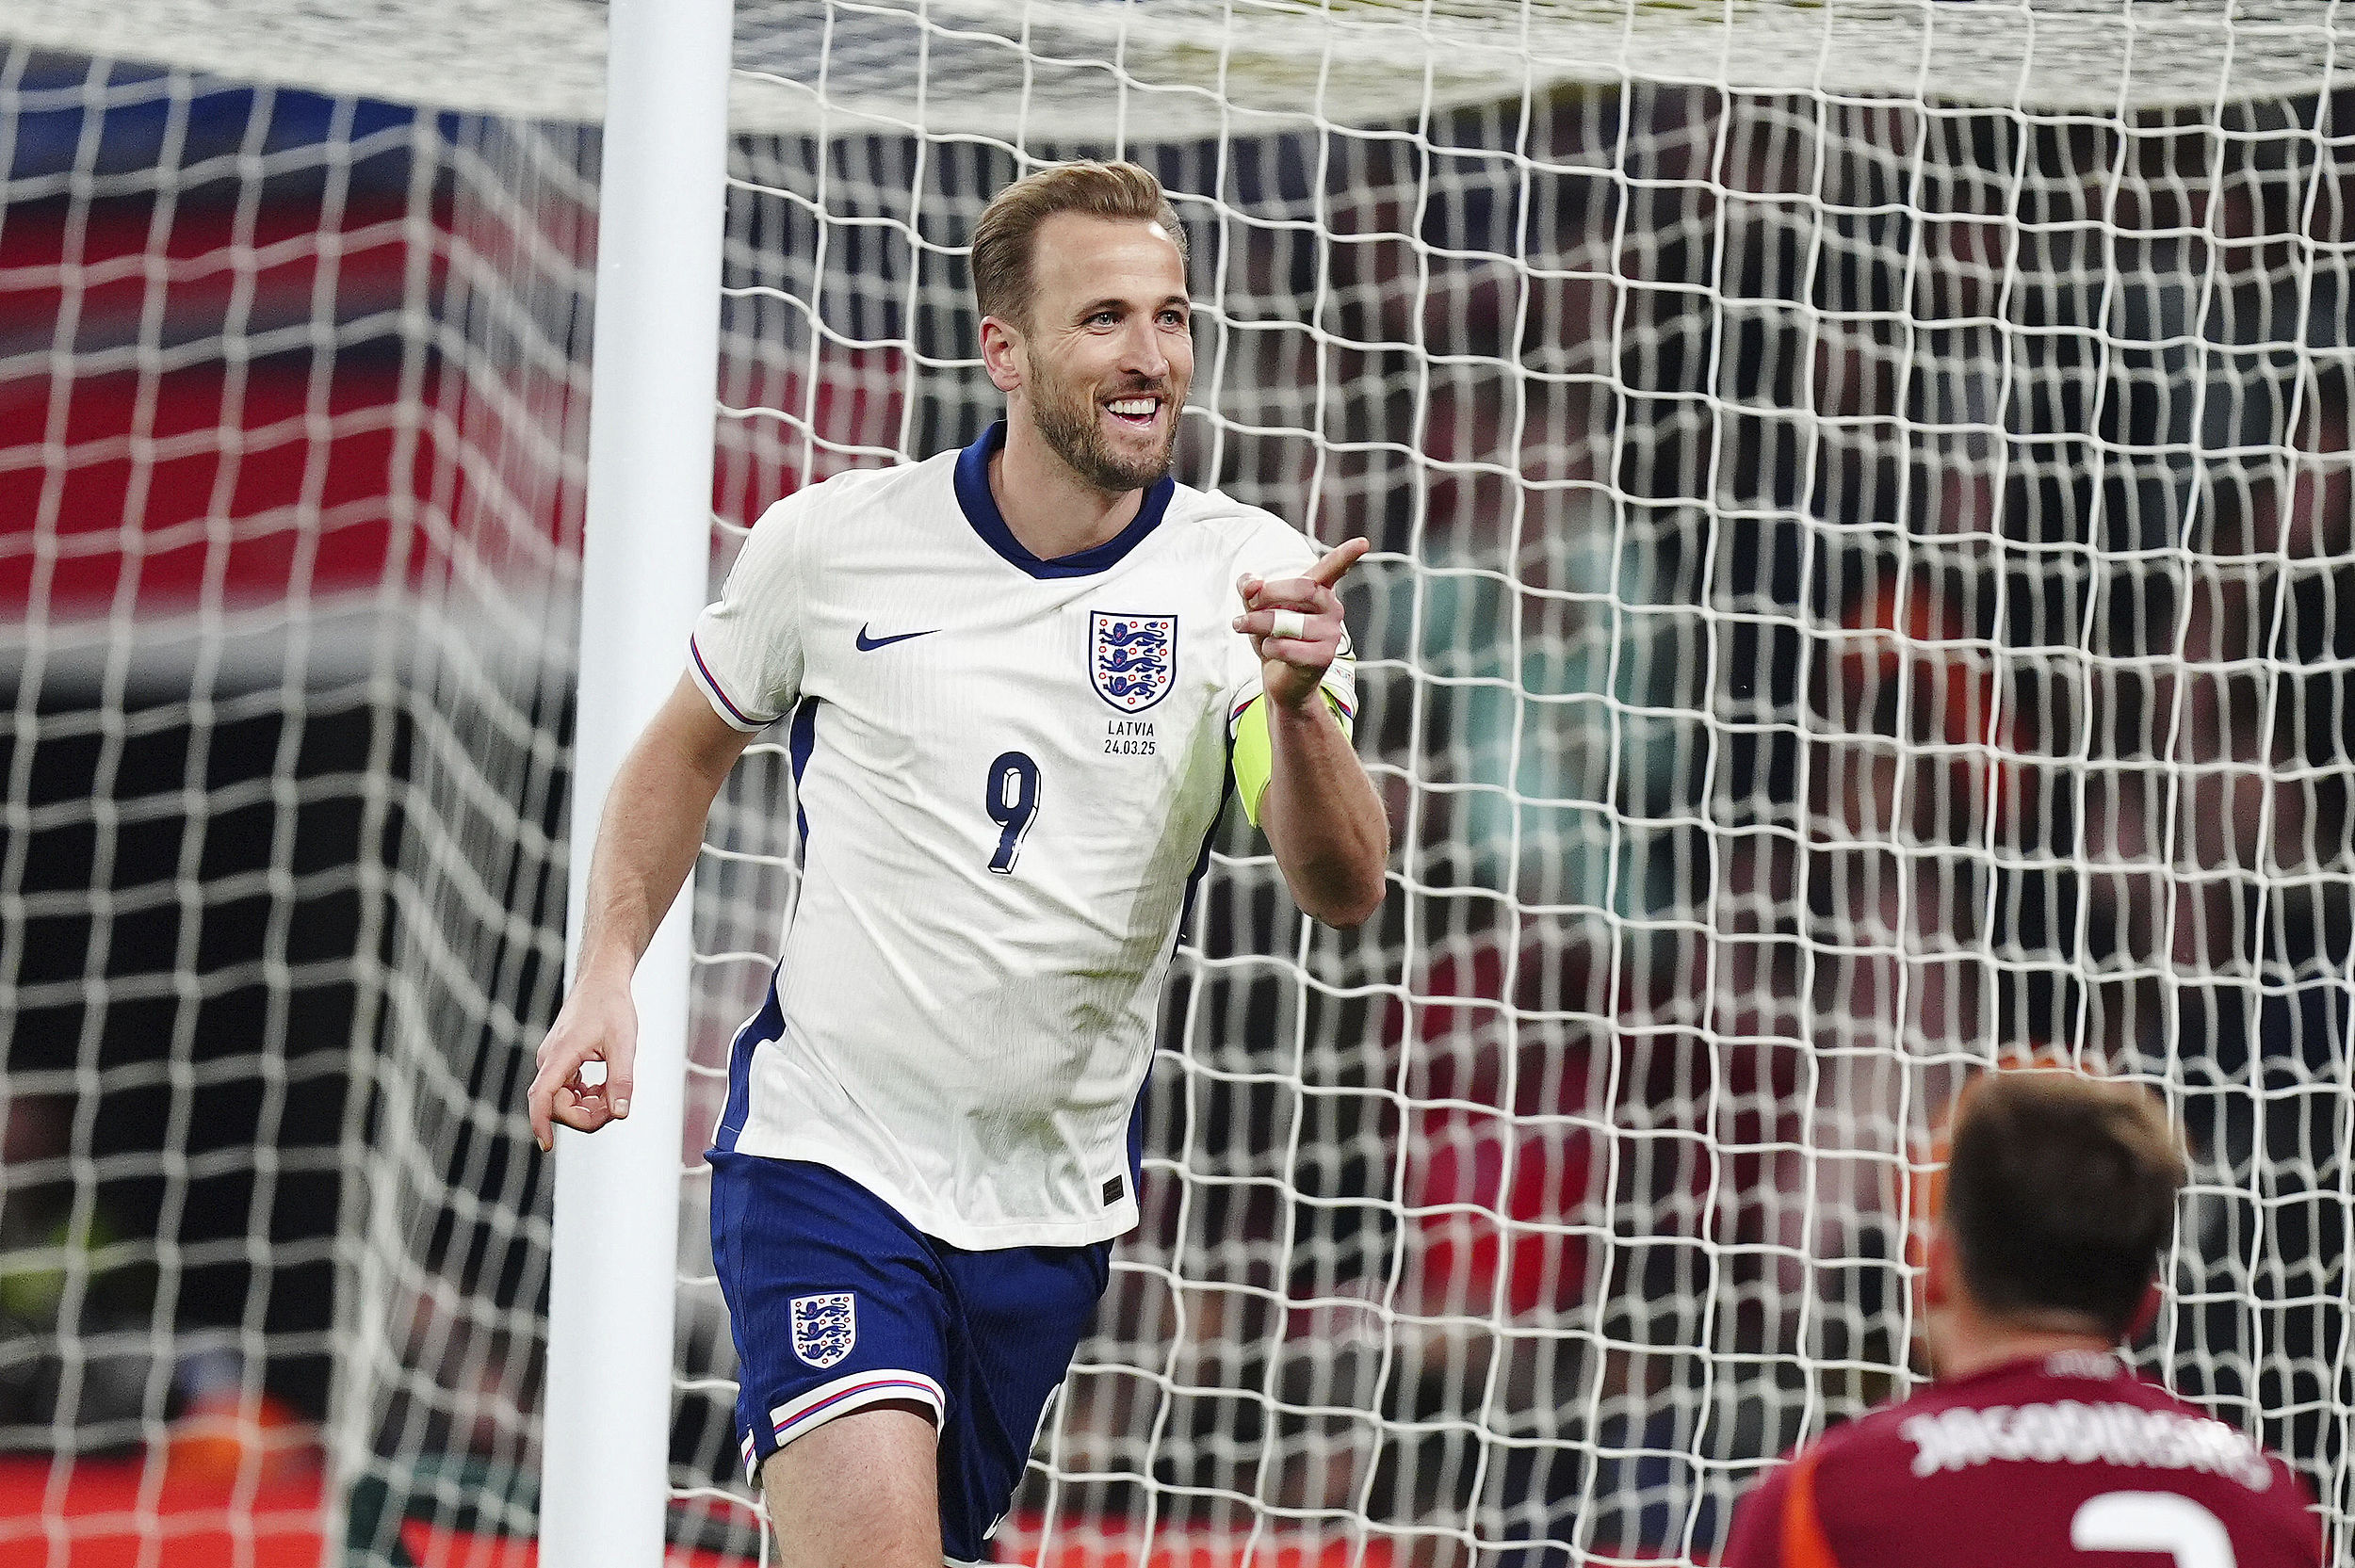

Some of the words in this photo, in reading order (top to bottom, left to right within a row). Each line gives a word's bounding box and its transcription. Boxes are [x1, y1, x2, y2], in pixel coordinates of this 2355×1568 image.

[1108, 719, 1155, 737] LATVIA
[1104, 739, 1156, 755] 24.03.25
[986, 751, 1042, 875] 9
